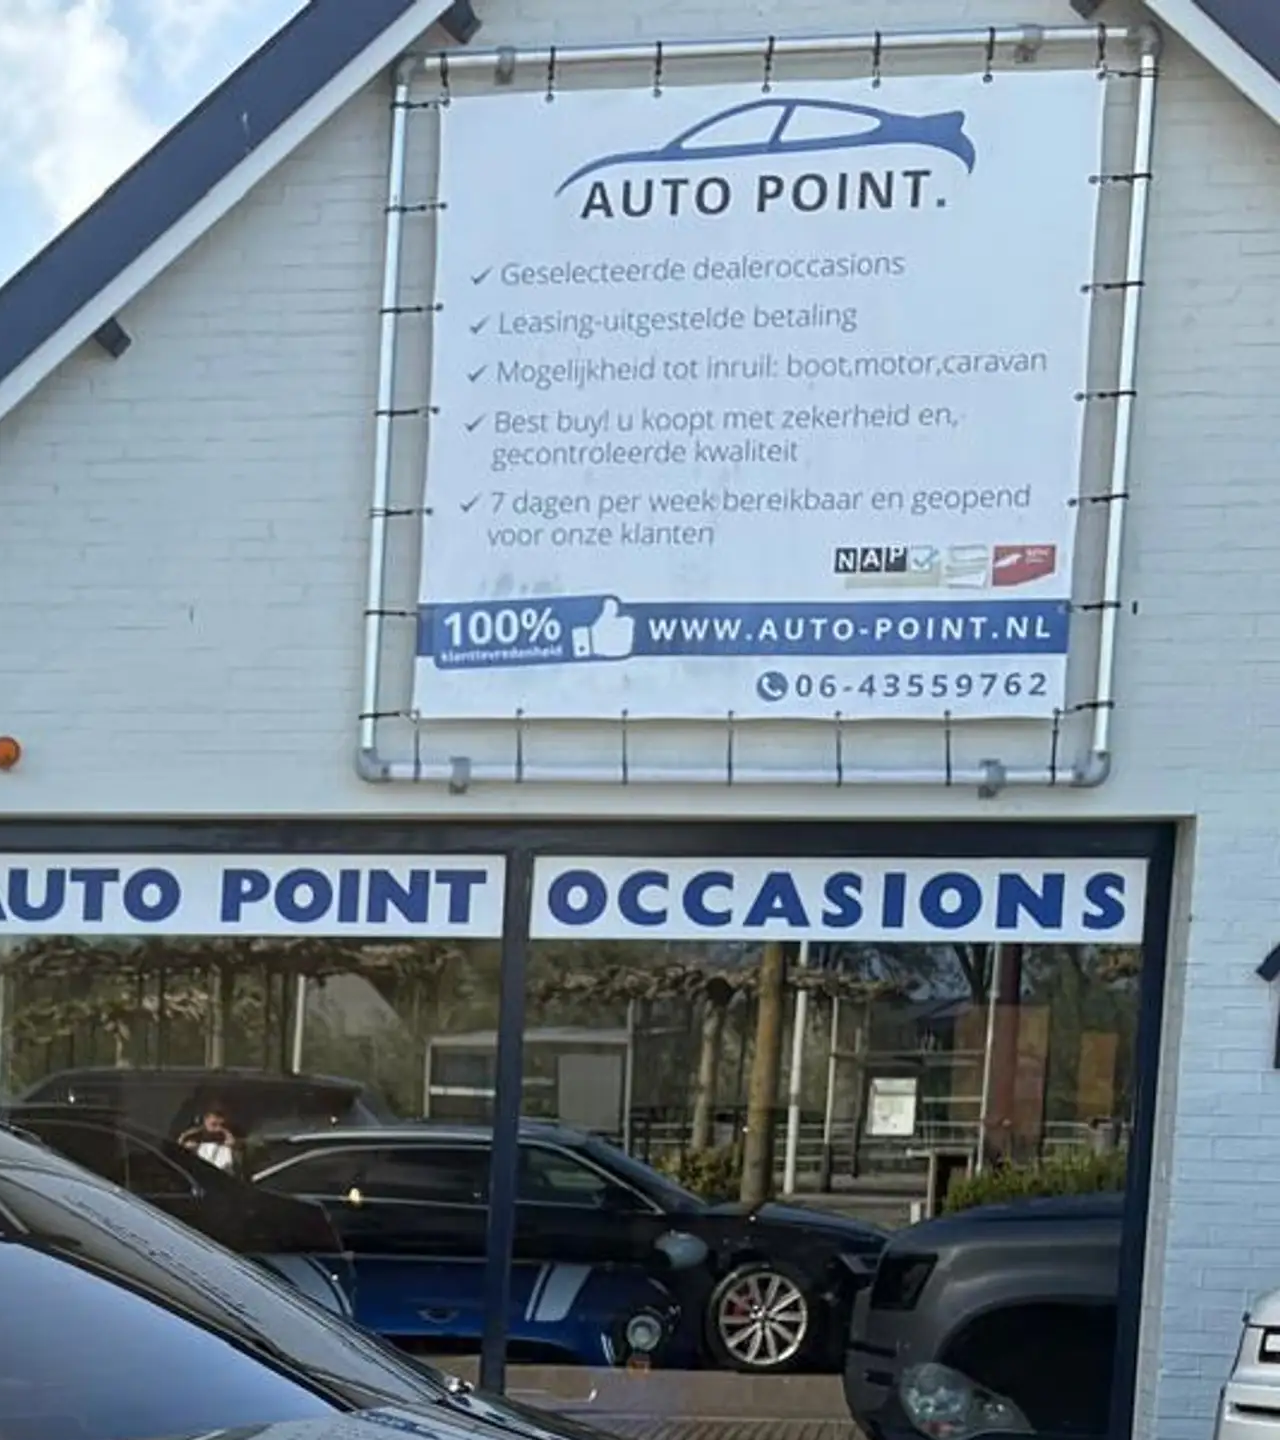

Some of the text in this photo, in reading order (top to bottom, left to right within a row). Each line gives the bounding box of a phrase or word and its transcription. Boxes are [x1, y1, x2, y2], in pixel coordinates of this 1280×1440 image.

[580, 169, 946, 220] AUTO POINT.
[500, 253, 905, 286] Geselecteerde dealeroccasions
[498, 303, 857, 339] Leasing-uitgestelde betaling
[497, 356, 655, 390] Mogelijkheid
[663, 361, 698, 380] tot
[706, 354, 777, 379] inruil:
[494, 403, 958, 437] Best buy! u koopt met zekerheid en,
[491, 438, 798, 472] gecontroleerde kwaliteit
[491, 484, 1031, 519] 7 dagen per week bereikbaar en geopend
[487, 521, 714, 546] voor onze klanten
[836, 546, 906, 573] NAP
[444, 607, 561, 647] 100%
[648, 615, 1052, 642] WWW.AUTO-POINT.NL
[795, 672, 1047, 699] 06-43559762
[220, 868, 487, 924] POINT
[547, 869, 1127, 930] OCCASIONS
